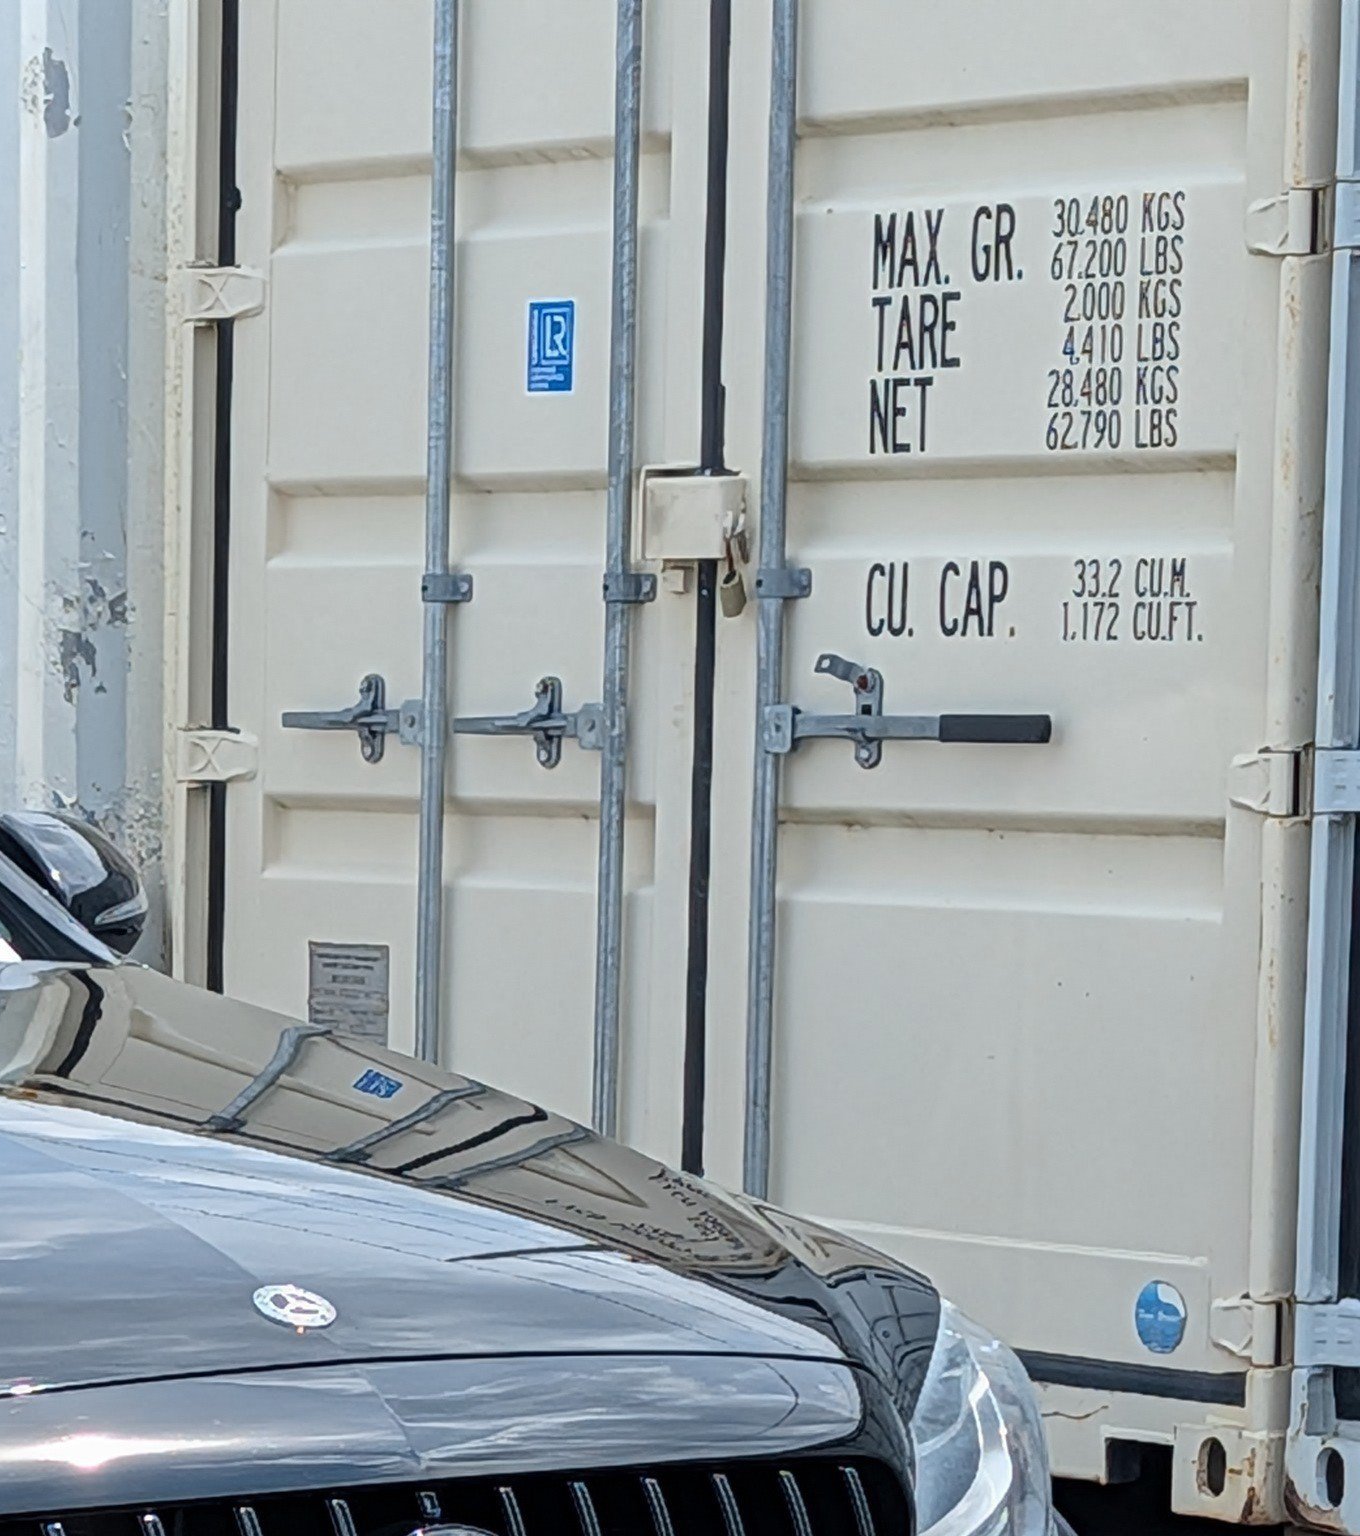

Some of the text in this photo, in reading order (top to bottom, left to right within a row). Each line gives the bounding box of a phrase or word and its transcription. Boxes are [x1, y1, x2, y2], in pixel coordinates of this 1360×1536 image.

[1141, 190, 1185, 234] KGS
[873, 203, 1023, 290] MAX. GR.
[1140, 235, 1184, 276] LBS
[1138, 278, 1182, 319] KGS
[871, 291, 961, 372] TARE
[1137, 321, 1180, 362] LBS
[1135, 364, 1179, 405] KGS
[869, 376, 934, 454] NET
[1135, 408, 1178, 449] LBS
[1072, 558, 1122, 598] 33.2
[866, 560, 1015, 638] CU. CAP.
[1133, 600, 1204, 642] CU.FT.
